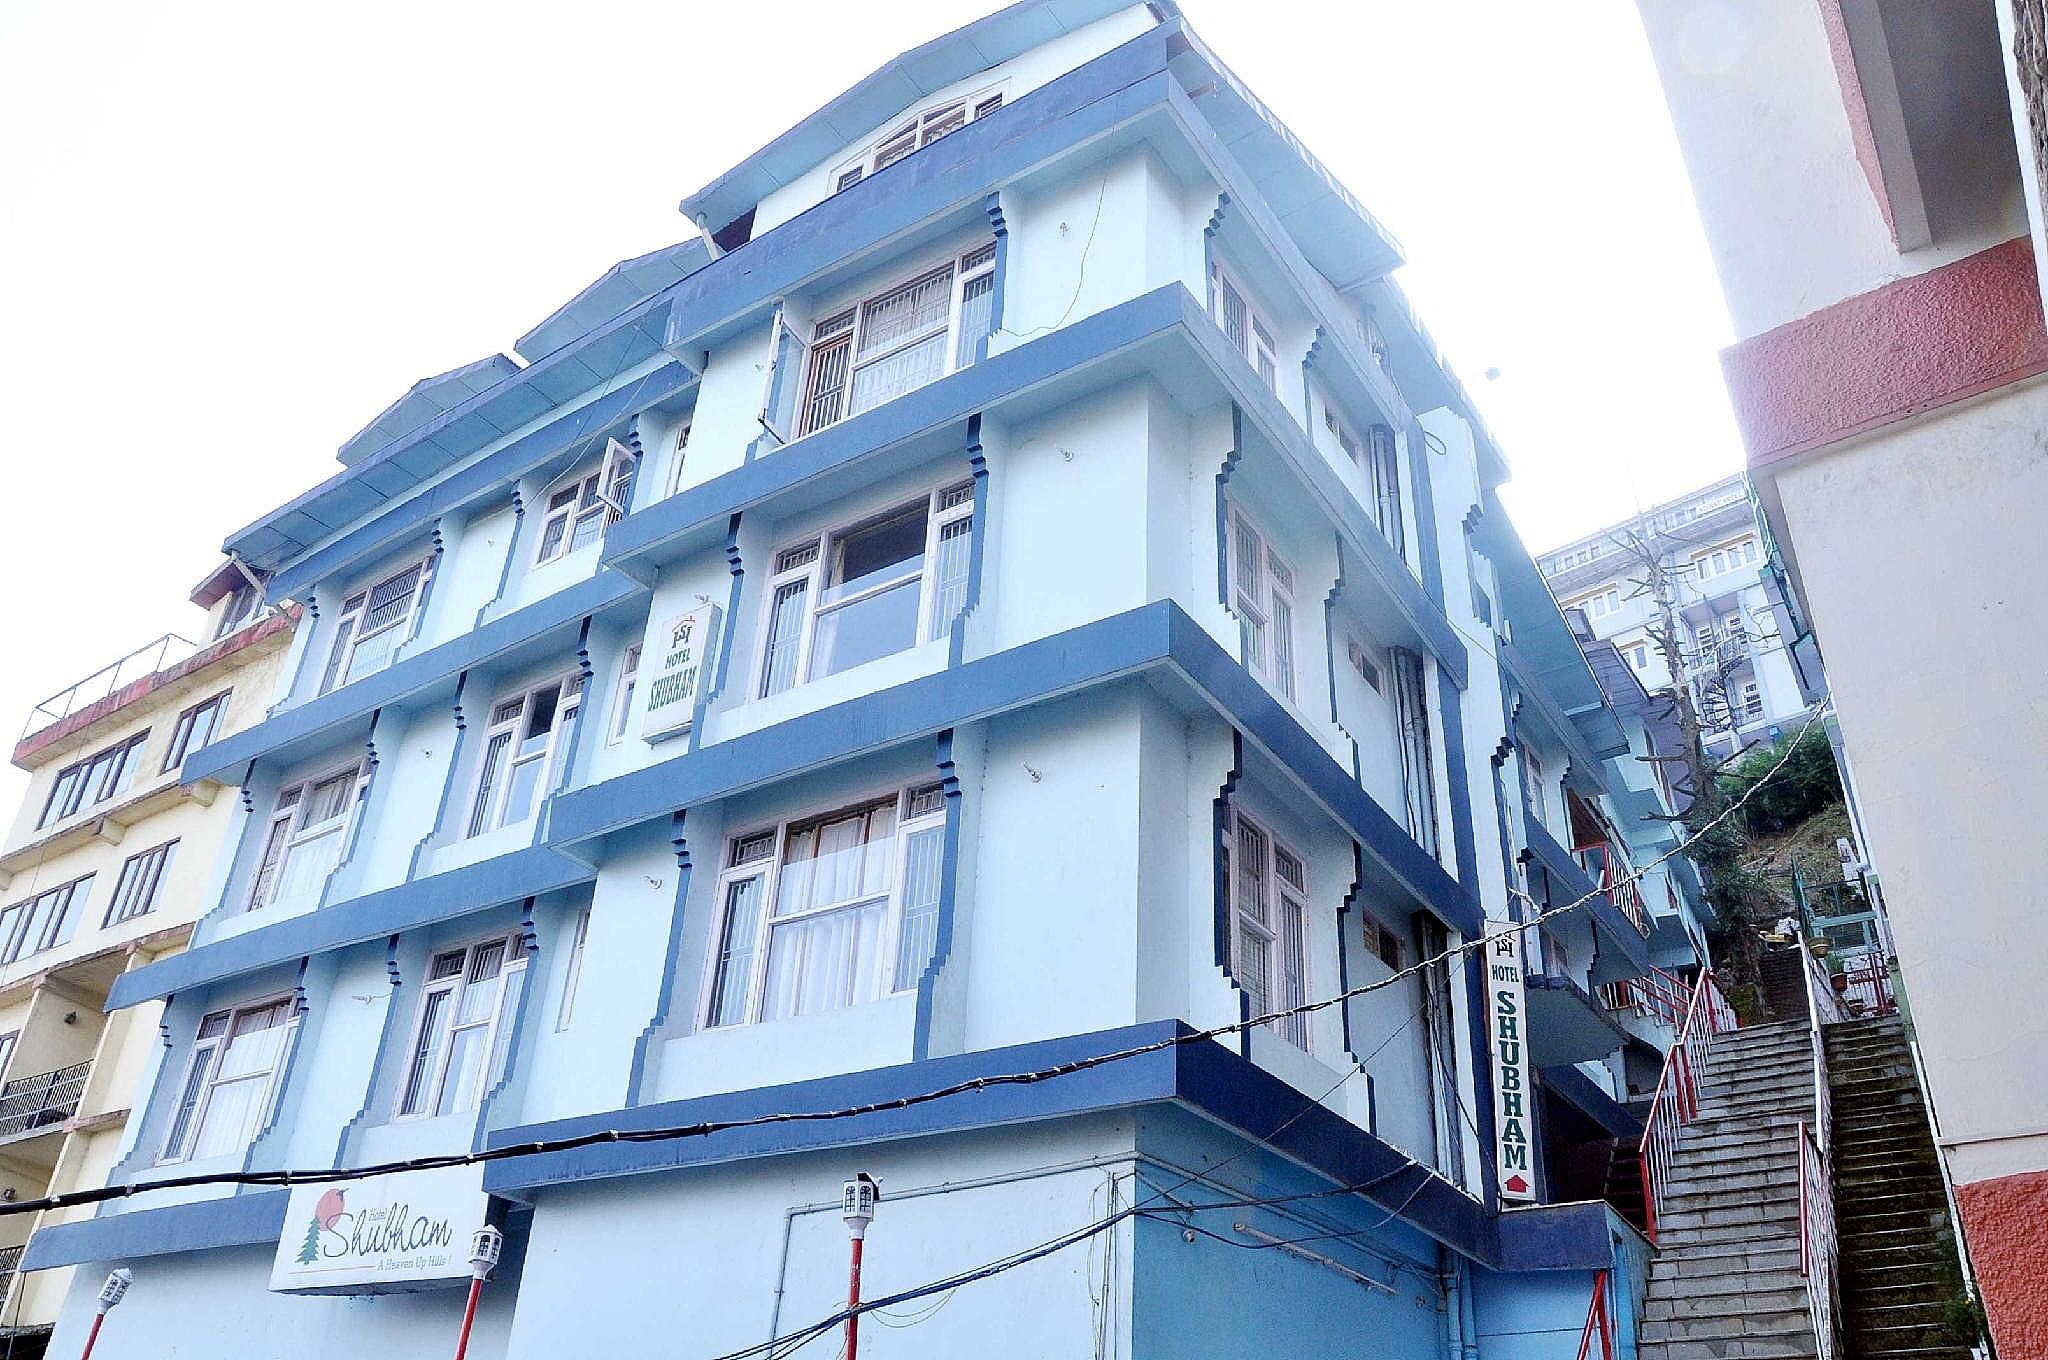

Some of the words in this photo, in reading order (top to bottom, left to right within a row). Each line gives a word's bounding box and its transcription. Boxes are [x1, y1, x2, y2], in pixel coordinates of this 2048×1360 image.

[665, 648, 691, 669] HOTEL
[648, 666, 697, 712] SHUBHAM
[1491, 964, 1520, 983] HOTEL
[1497, 990, 1527, 1171] SHUBHAM
[323, 1202, 452, 1258] Shubham
